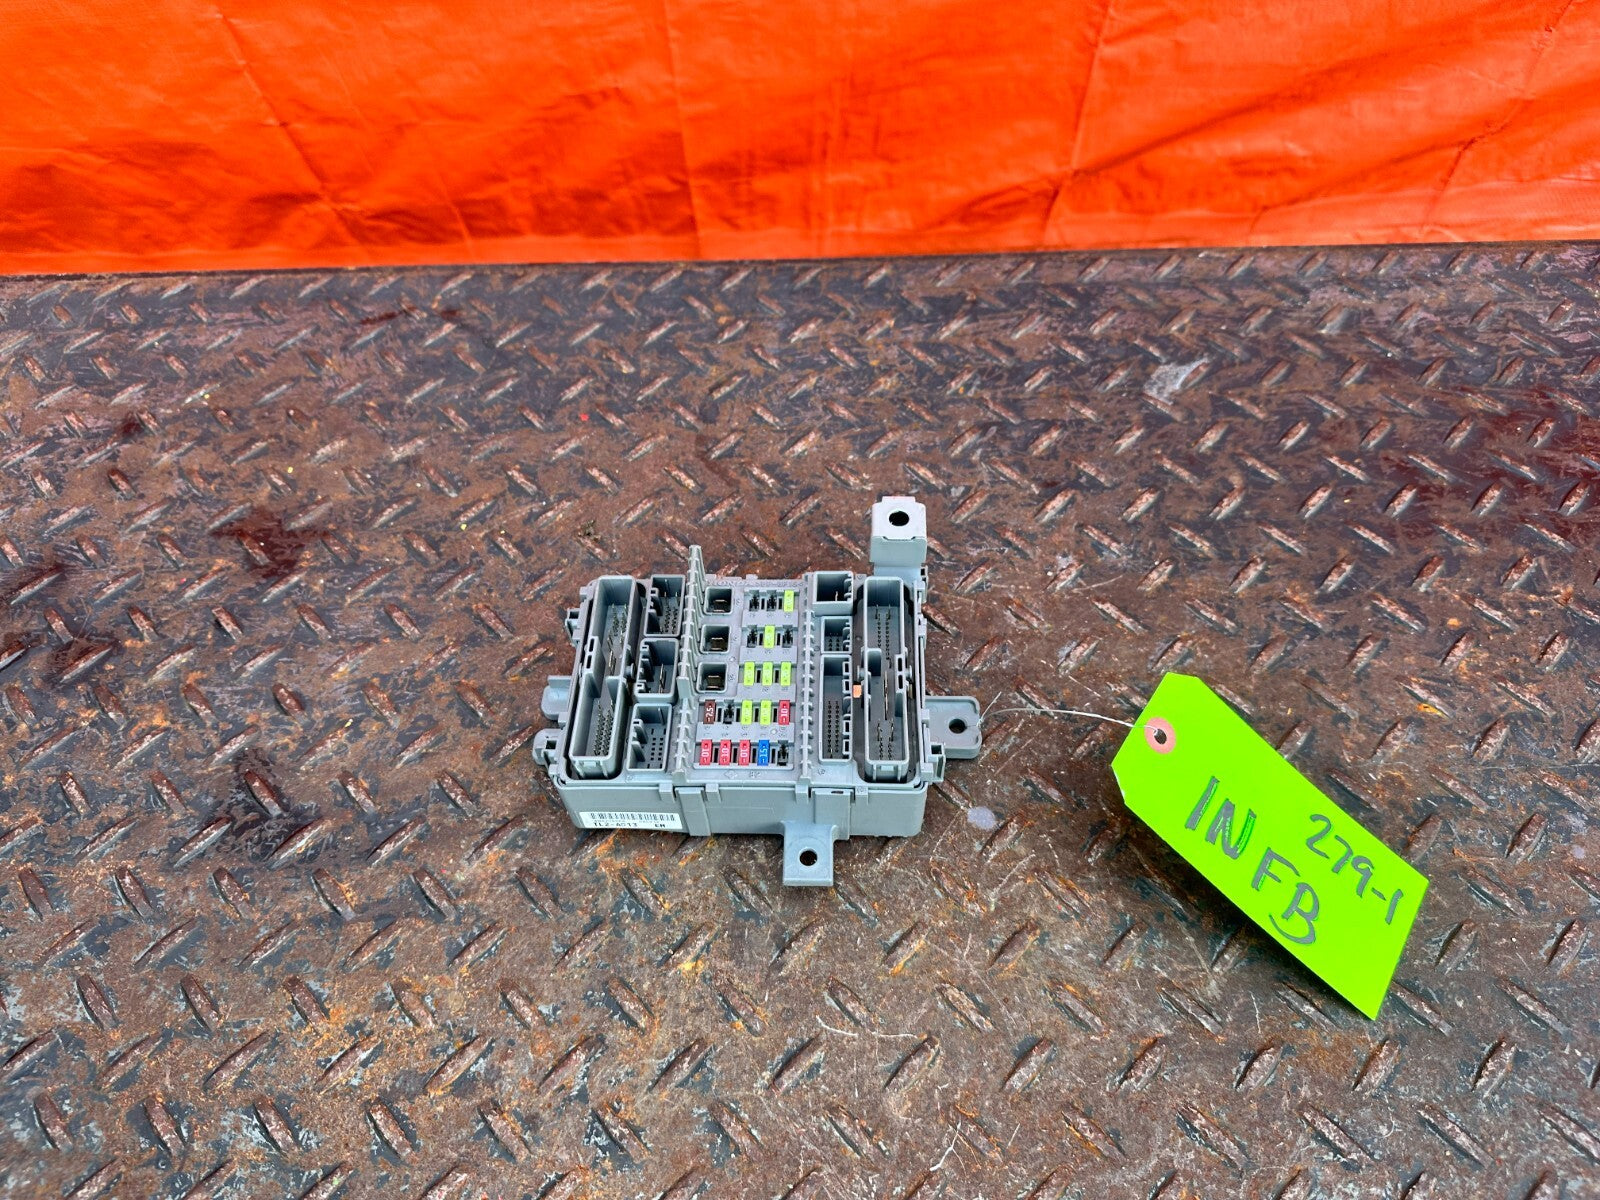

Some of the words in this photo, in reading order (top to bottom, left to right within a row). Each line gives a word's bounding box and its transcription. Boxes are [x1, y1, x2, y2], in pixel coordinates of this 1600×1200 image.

[705, 707, 714, 718] 7.5
[780, 708, 788, 717] 10
[701, 748, 709, 757] 10
[721, 748, 730, 757] 10
[740, 749, 748, 758] 10
[759, 748, 768, 757] 15
[1305, 813, 1404, 925] 279-1
